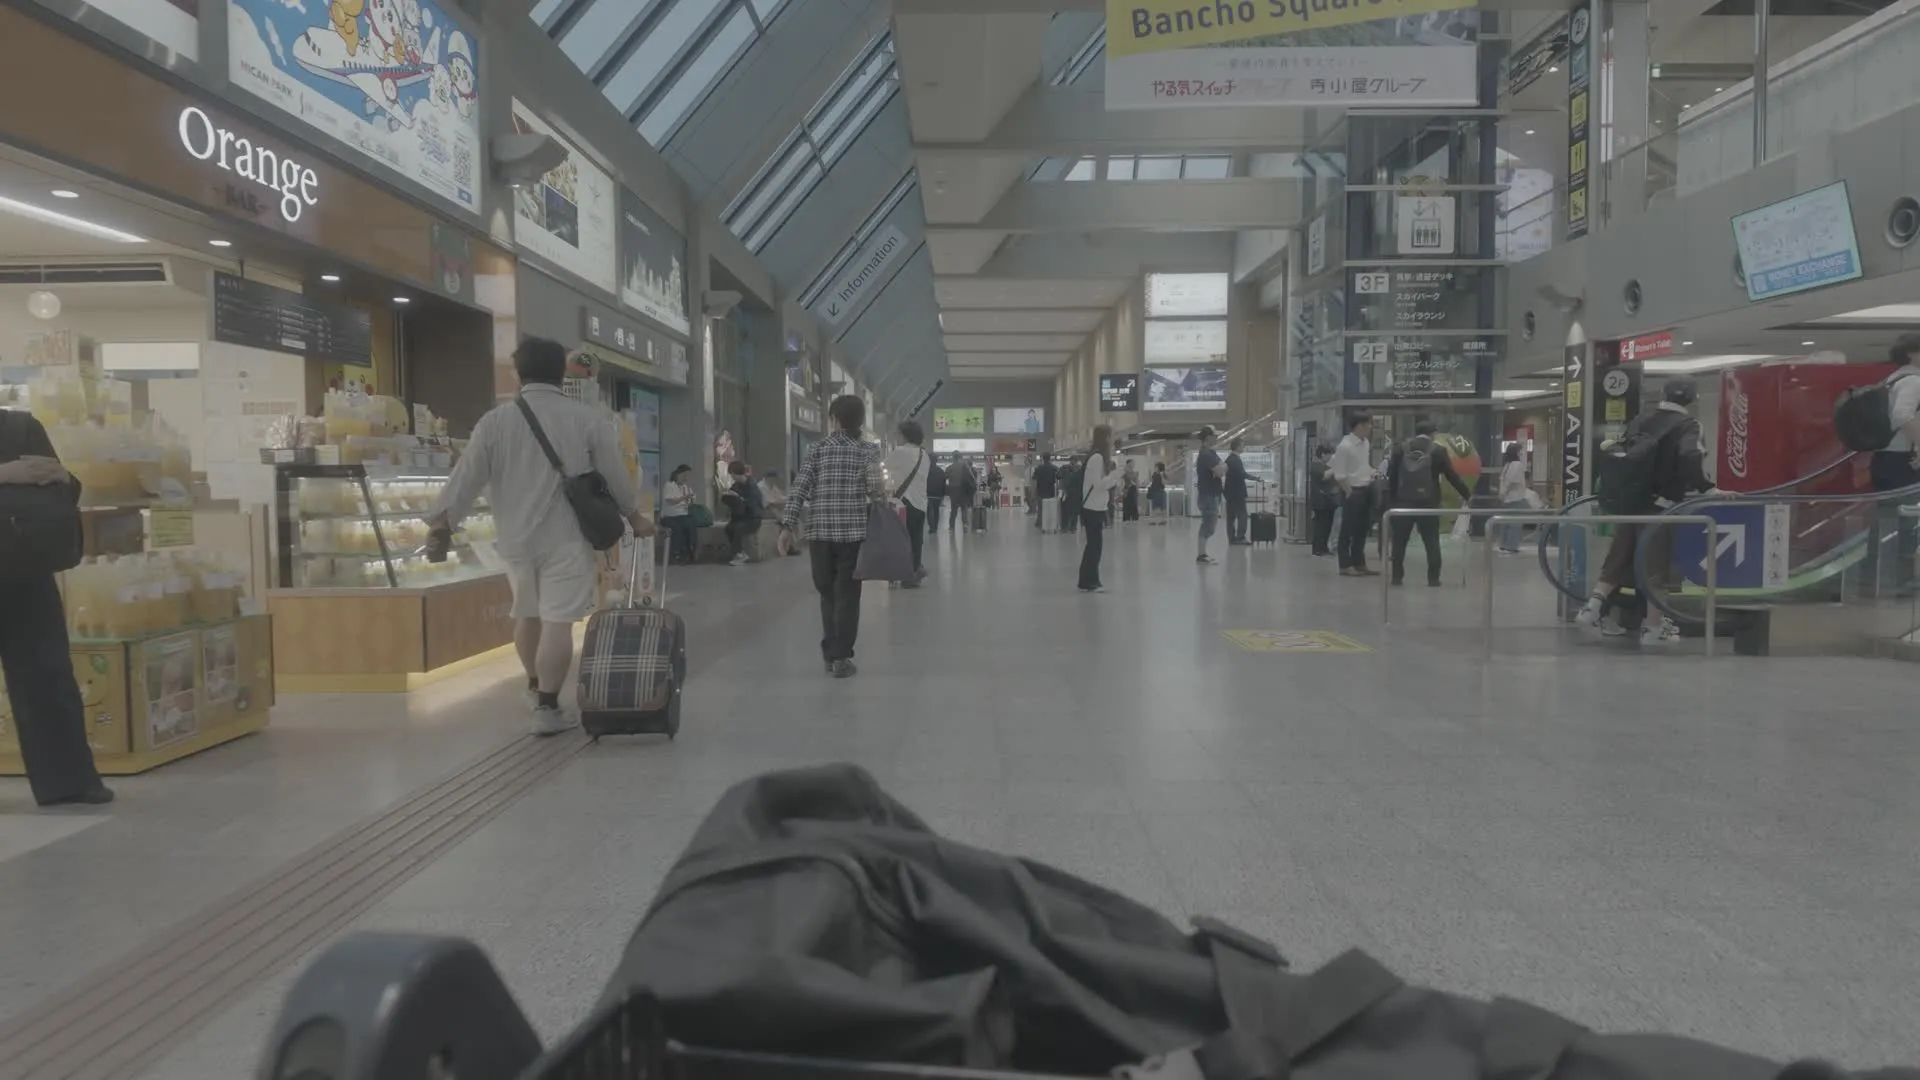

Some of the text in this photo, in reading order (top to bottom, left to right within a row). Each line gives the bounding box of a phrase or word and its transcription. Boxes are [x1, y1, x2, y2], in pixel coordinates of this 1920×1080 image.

[1132, 0, 1255, 38] Bancho
[179, 106, 318, 222] Orange
[839, 235, 900, 302] Information
[1798, 254, 1847, 275] EXCHANGE
[1360, 275, 1385, 291] 3F
[1359, 345, 1384, 361] 2F
[1608, 376, 1626, 390] 2F
[1565, 413, 1581, 484] ATM
